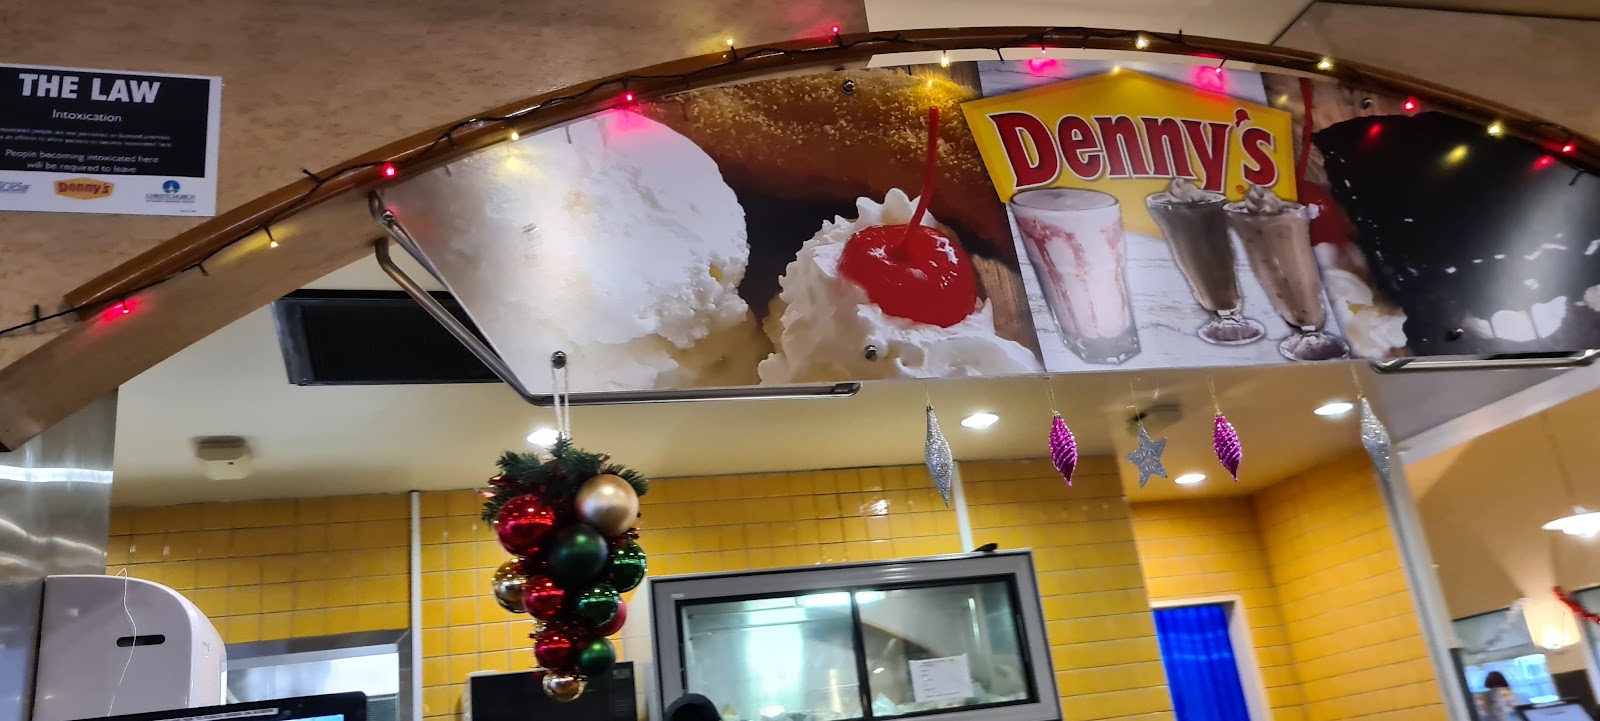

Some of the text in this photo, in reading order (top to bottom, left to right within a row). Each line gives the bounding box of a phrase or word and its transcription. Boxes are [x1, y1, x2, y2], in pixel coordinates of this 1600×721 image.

[19, 73, 161, 104] THE LAW
[52, 108, 122, 123] Intoxication
[5, 148, 160, 164] People becoming intoxicated here
[986, 107, 1279, 192] Denny's
[26, 161, 137, 173] will be required to leave
[57, 181, 111, 195] Denny's
